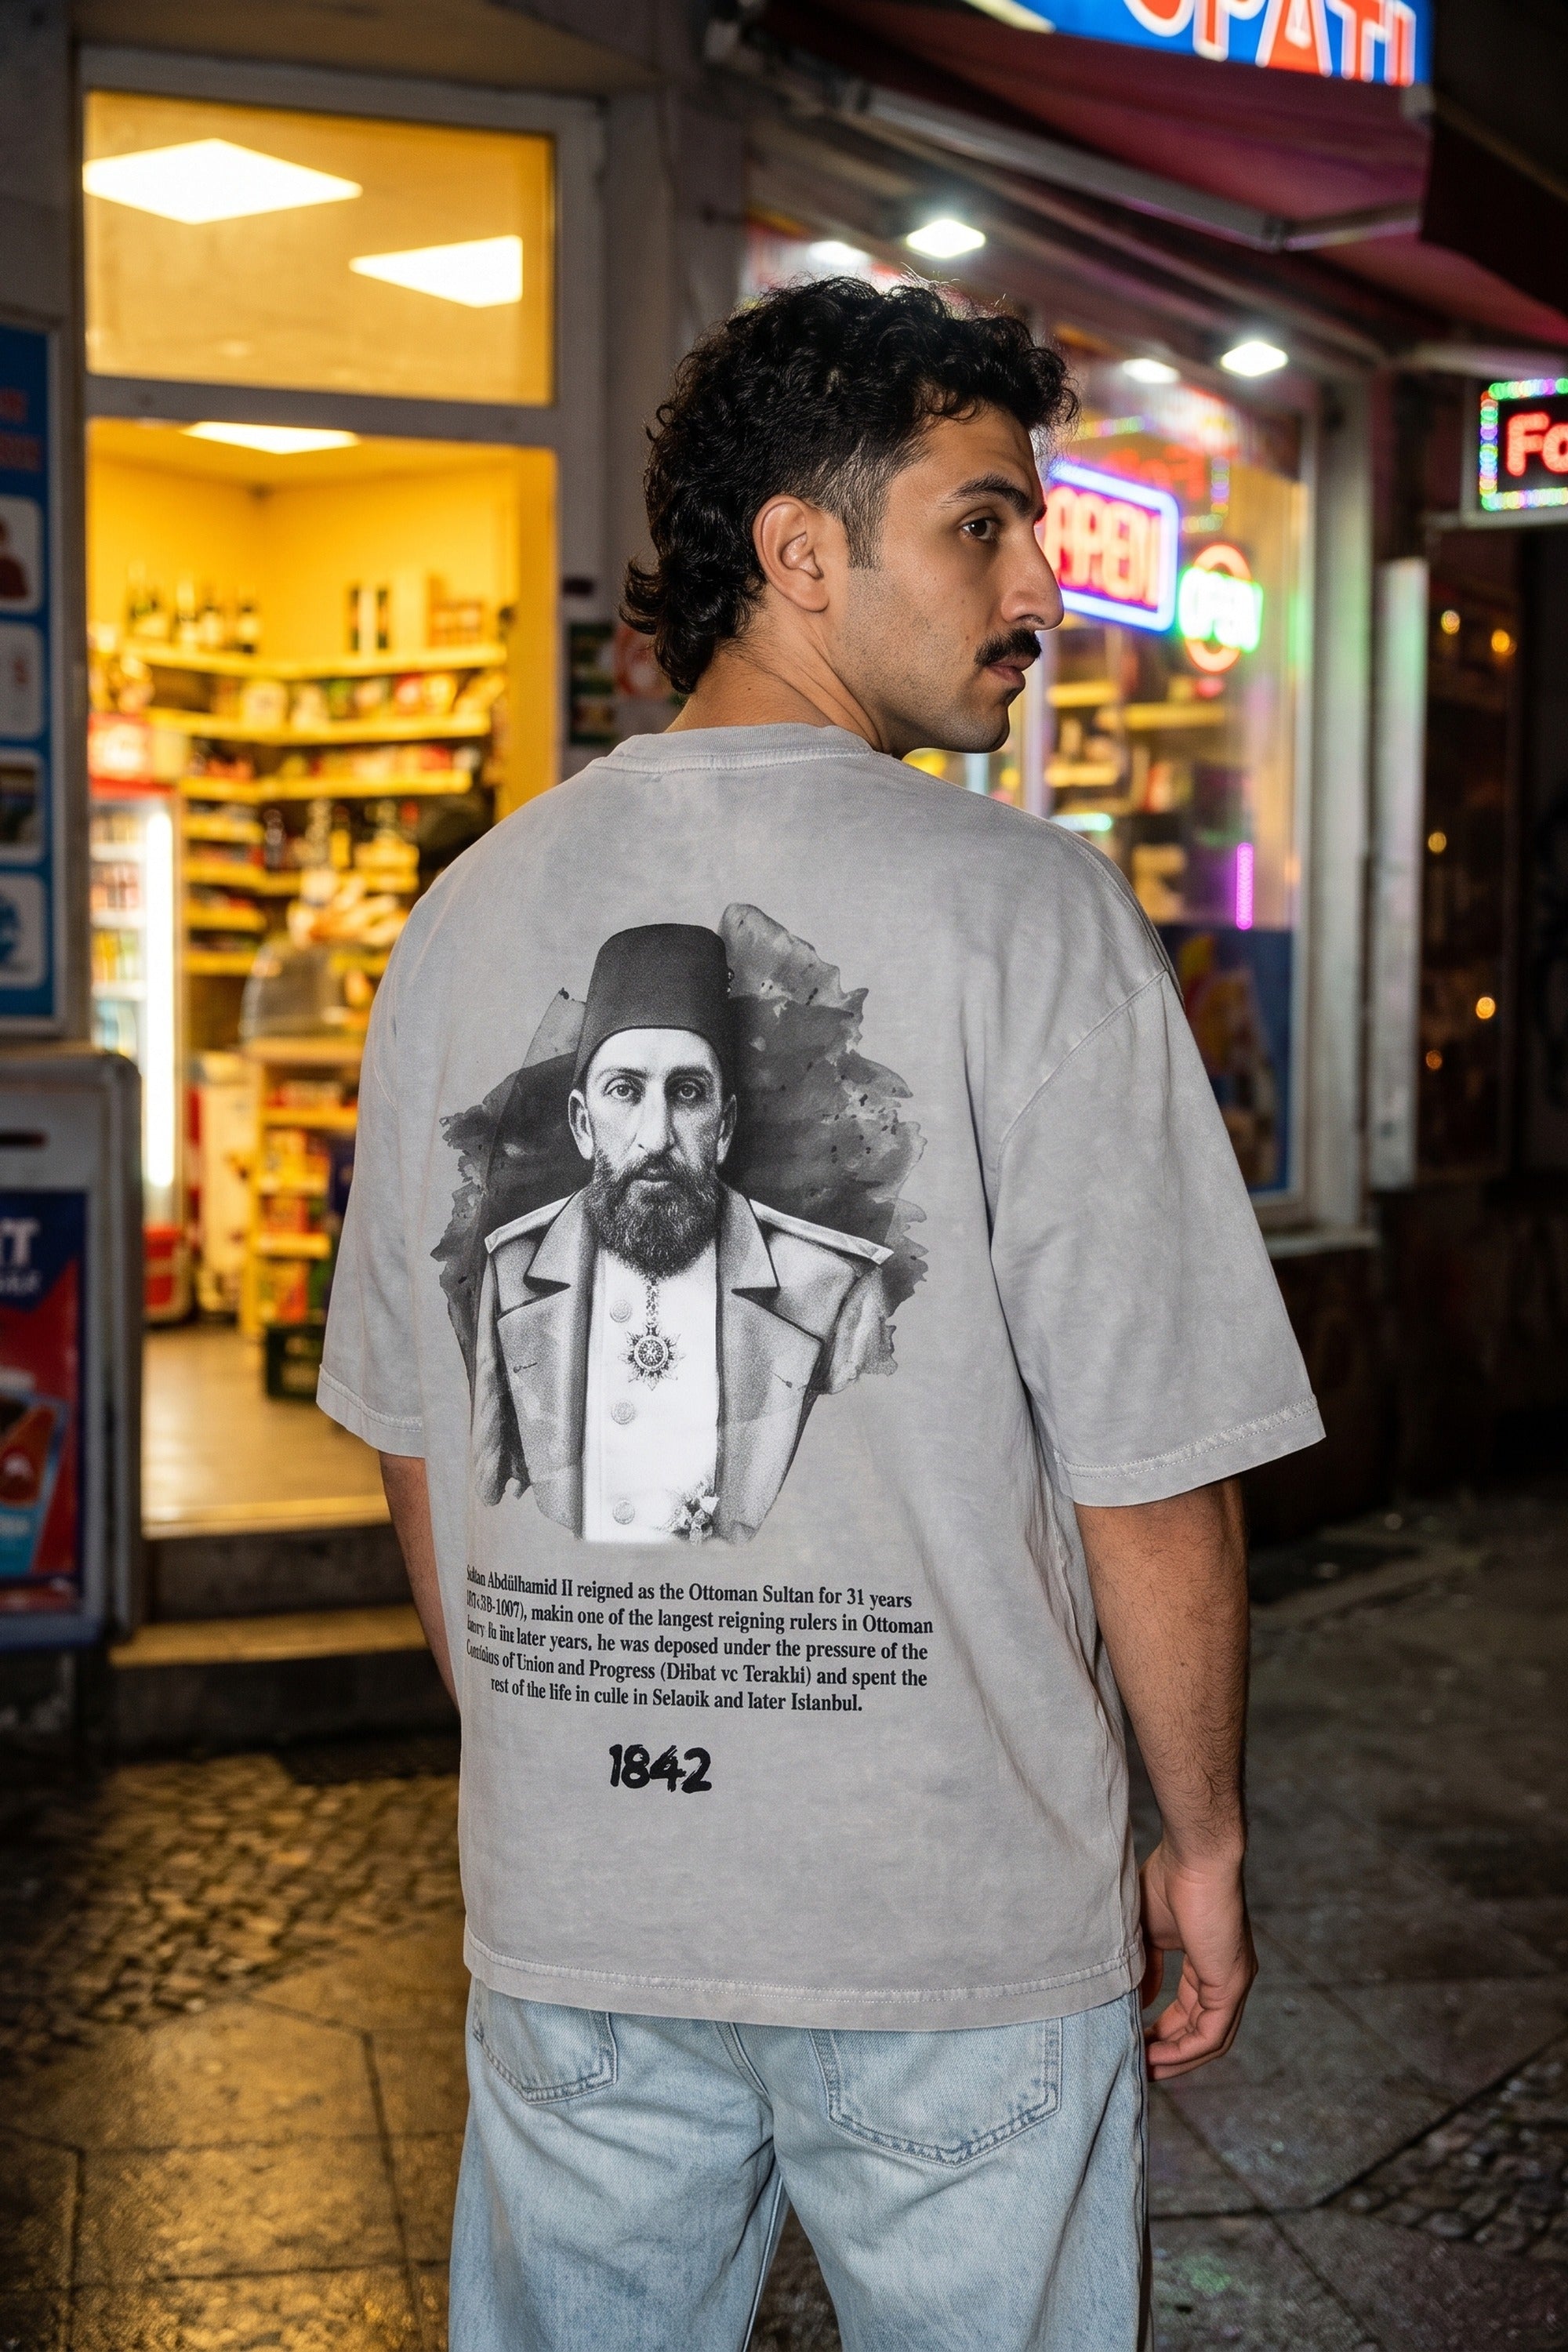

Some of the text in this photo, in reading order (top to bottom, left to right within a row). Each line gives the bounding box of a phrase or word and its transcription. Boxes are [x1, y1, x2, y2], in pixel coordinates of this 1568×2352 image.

[488, 1571, 557, 1595] Abdülhamid
[561, 1579, 573, 1596] II
[577, 1581, 633, 1603] reigned
[638, 1587, 655, 1600] as
[659, 1583, 684, 1599] the
[689, 1583, 758, 1602] Ottoman
[763, 1585, 814, 1603] Sultan
[818, 1587, 842, 1605] for
[847, 1588, 864, 1605] 31
[869, 1593, 912, 1610] years
[531, 1604, 573, 1622] makin
[577, 1611, 604, 1624] one
[608, 1608, 625, 1624] of
[629, 1609, 653, 1626] the
[658, 1609, 713, 1632] langest
[718, 1611, 785, 1635] reigning
[789, 1613, 837, 1631] rulers
[842, 1613, 858, 1631] in
[862, 1614, 933, 1634] Ottoman
[517, 1627, 546, 1646] later
[597, 1634, 615, 1650] he
[620, 1639, 649, 1652] was
[654, 1635, 718, 1658] deposed
[724, 1638, 771, 1656] under
[775, 1639, 800, 1657] the
[806, 1644, 876, 1662] pressure
[881, 1642, 898, 1659] of
[902, 1643, 927, 1660] the
[503, 1651, 515, 1668] of
[517, 1653, 554, 1673] Union
[558, 1659, 585, 1675] and
[589, 1660, 655, 1682] Progress
[817, 1667, 847, 1685] and
[852, 1670, 896, 1690] spent
[902, 1669, 927, 1686] the
[491, 1678, 509, 1693] rest
[512, 1679, 524, 1696] of
[527, 1681, 546, 1699] the
[575, 1685, 590, 1702] in
[633, 1688, 648, 1705] in
[714, 1691, 743, 1708] and
[748, 1692, 786, 1710] later
[609, 1744, 712, 1794] 1842
